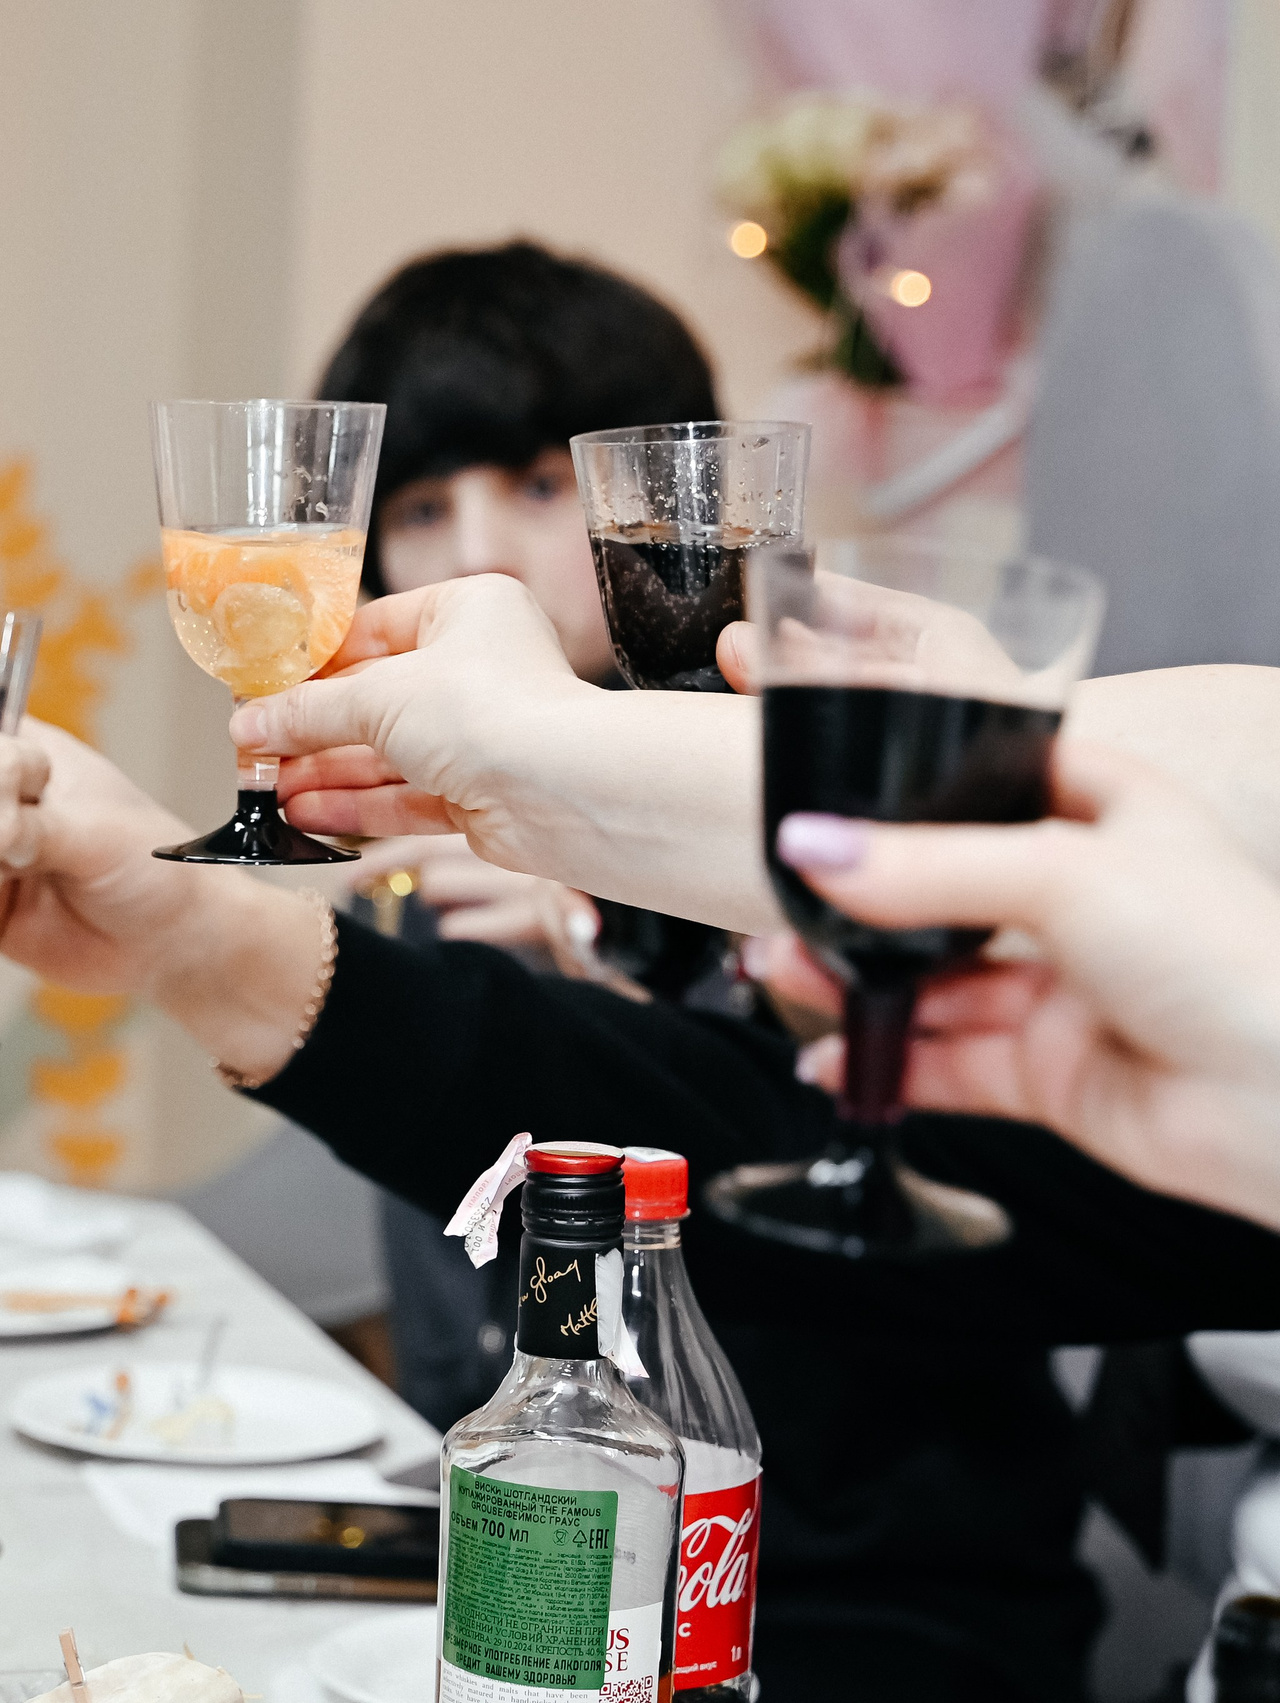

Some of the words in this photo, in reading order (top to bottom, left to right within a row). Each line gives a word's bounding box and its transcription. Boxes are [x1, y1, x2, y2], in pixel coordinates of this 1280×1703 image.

[474, 1480, 502, 1496] ВИСКИ
[504, 1488, 577, 1505] ШОТЛАНДСКИЙ
[540, 1505, 558, 1515] THE
[561, 1507, 601, 1517] FAMOUS
[451, 1511, 478, 1532] ОБЪЕМ
[481, 1517, 505, 1539] 700
[509, 1528, 529, 1543] МЛ
[549, 1516, 580, 1527] ГРАУС
[495, 1627, 543, 1643] УСЛОВИЙ
[506, 1618, 519, 1629] НЕ
[521, 1621, 582, 1636] ОГРАНИЧЕН
[585, 1626, 604, 1636] ПРИ
[494, 1637, 532, 1652] 29.10.2024
[535, 1644, 583, 1656] КРЕПОСТЬ
[455, 1652, 482, 1671] ВРЕДИТ
[485, 1663, 521, 1680] ВАШЕМУ
[523, 1670, 577, 1685] ЗДОРОВЬЮ
[484, 1647, 551, 1669] УПОТРЕБЛЕНИЕ
[554, 1659, 602, 1671] АЛКОГОЛЯ
